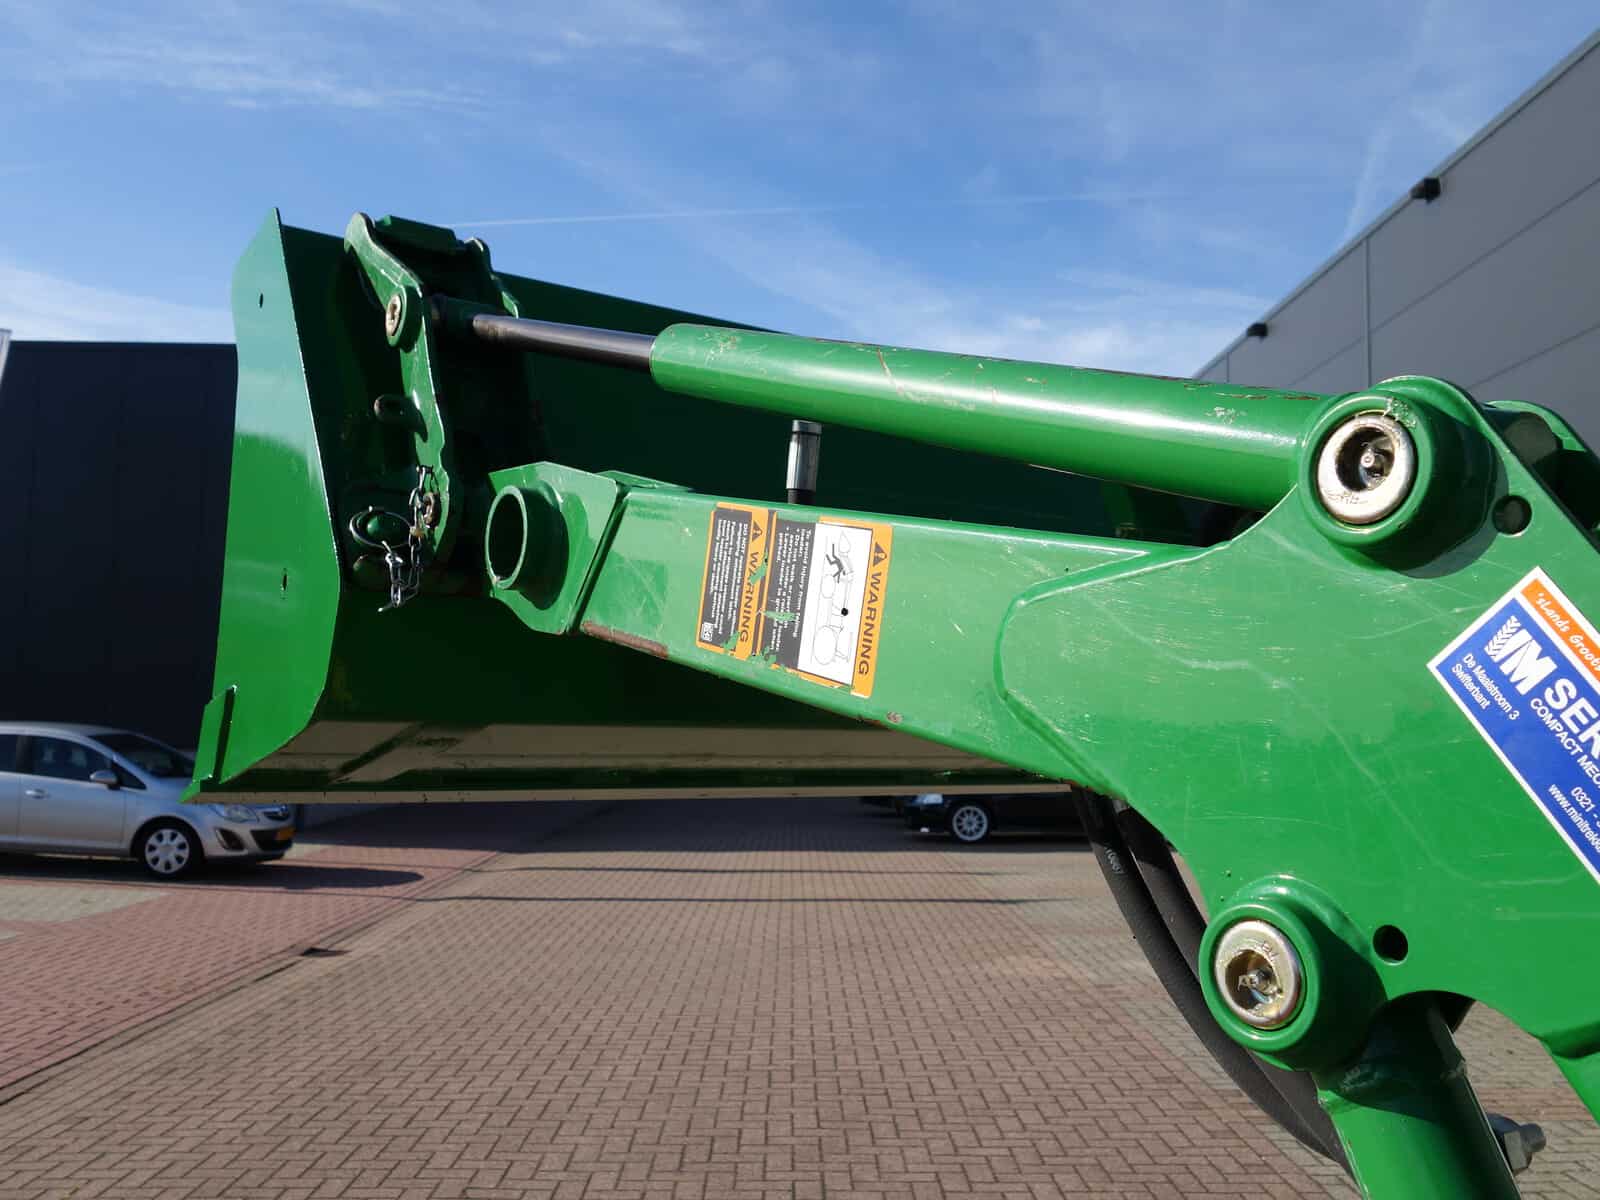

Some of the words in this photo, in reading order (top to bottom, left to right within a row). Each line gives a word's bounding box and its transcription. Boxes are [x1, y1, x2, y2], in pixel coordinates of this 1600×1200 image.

[794, 534, 799, 546] Do
[805, 529, 811, 539] To
[738, 550, 760, 643] WARNING
[798, 565, 806, 589] injury
[857, 570, 881, 677] WARNING
[1452, 664, 1490, 709] Swifterbant
[1463, 653, 1475, 668] De
[1472, 665, 1512, 712] Maalstroom
[1509, 711, 1519, 720] 3
[1531, 698, 1583, 755] COMPACT
[1577, 755, 1600, 788] MEC
[1572, 787, 1594, 811] 0321
